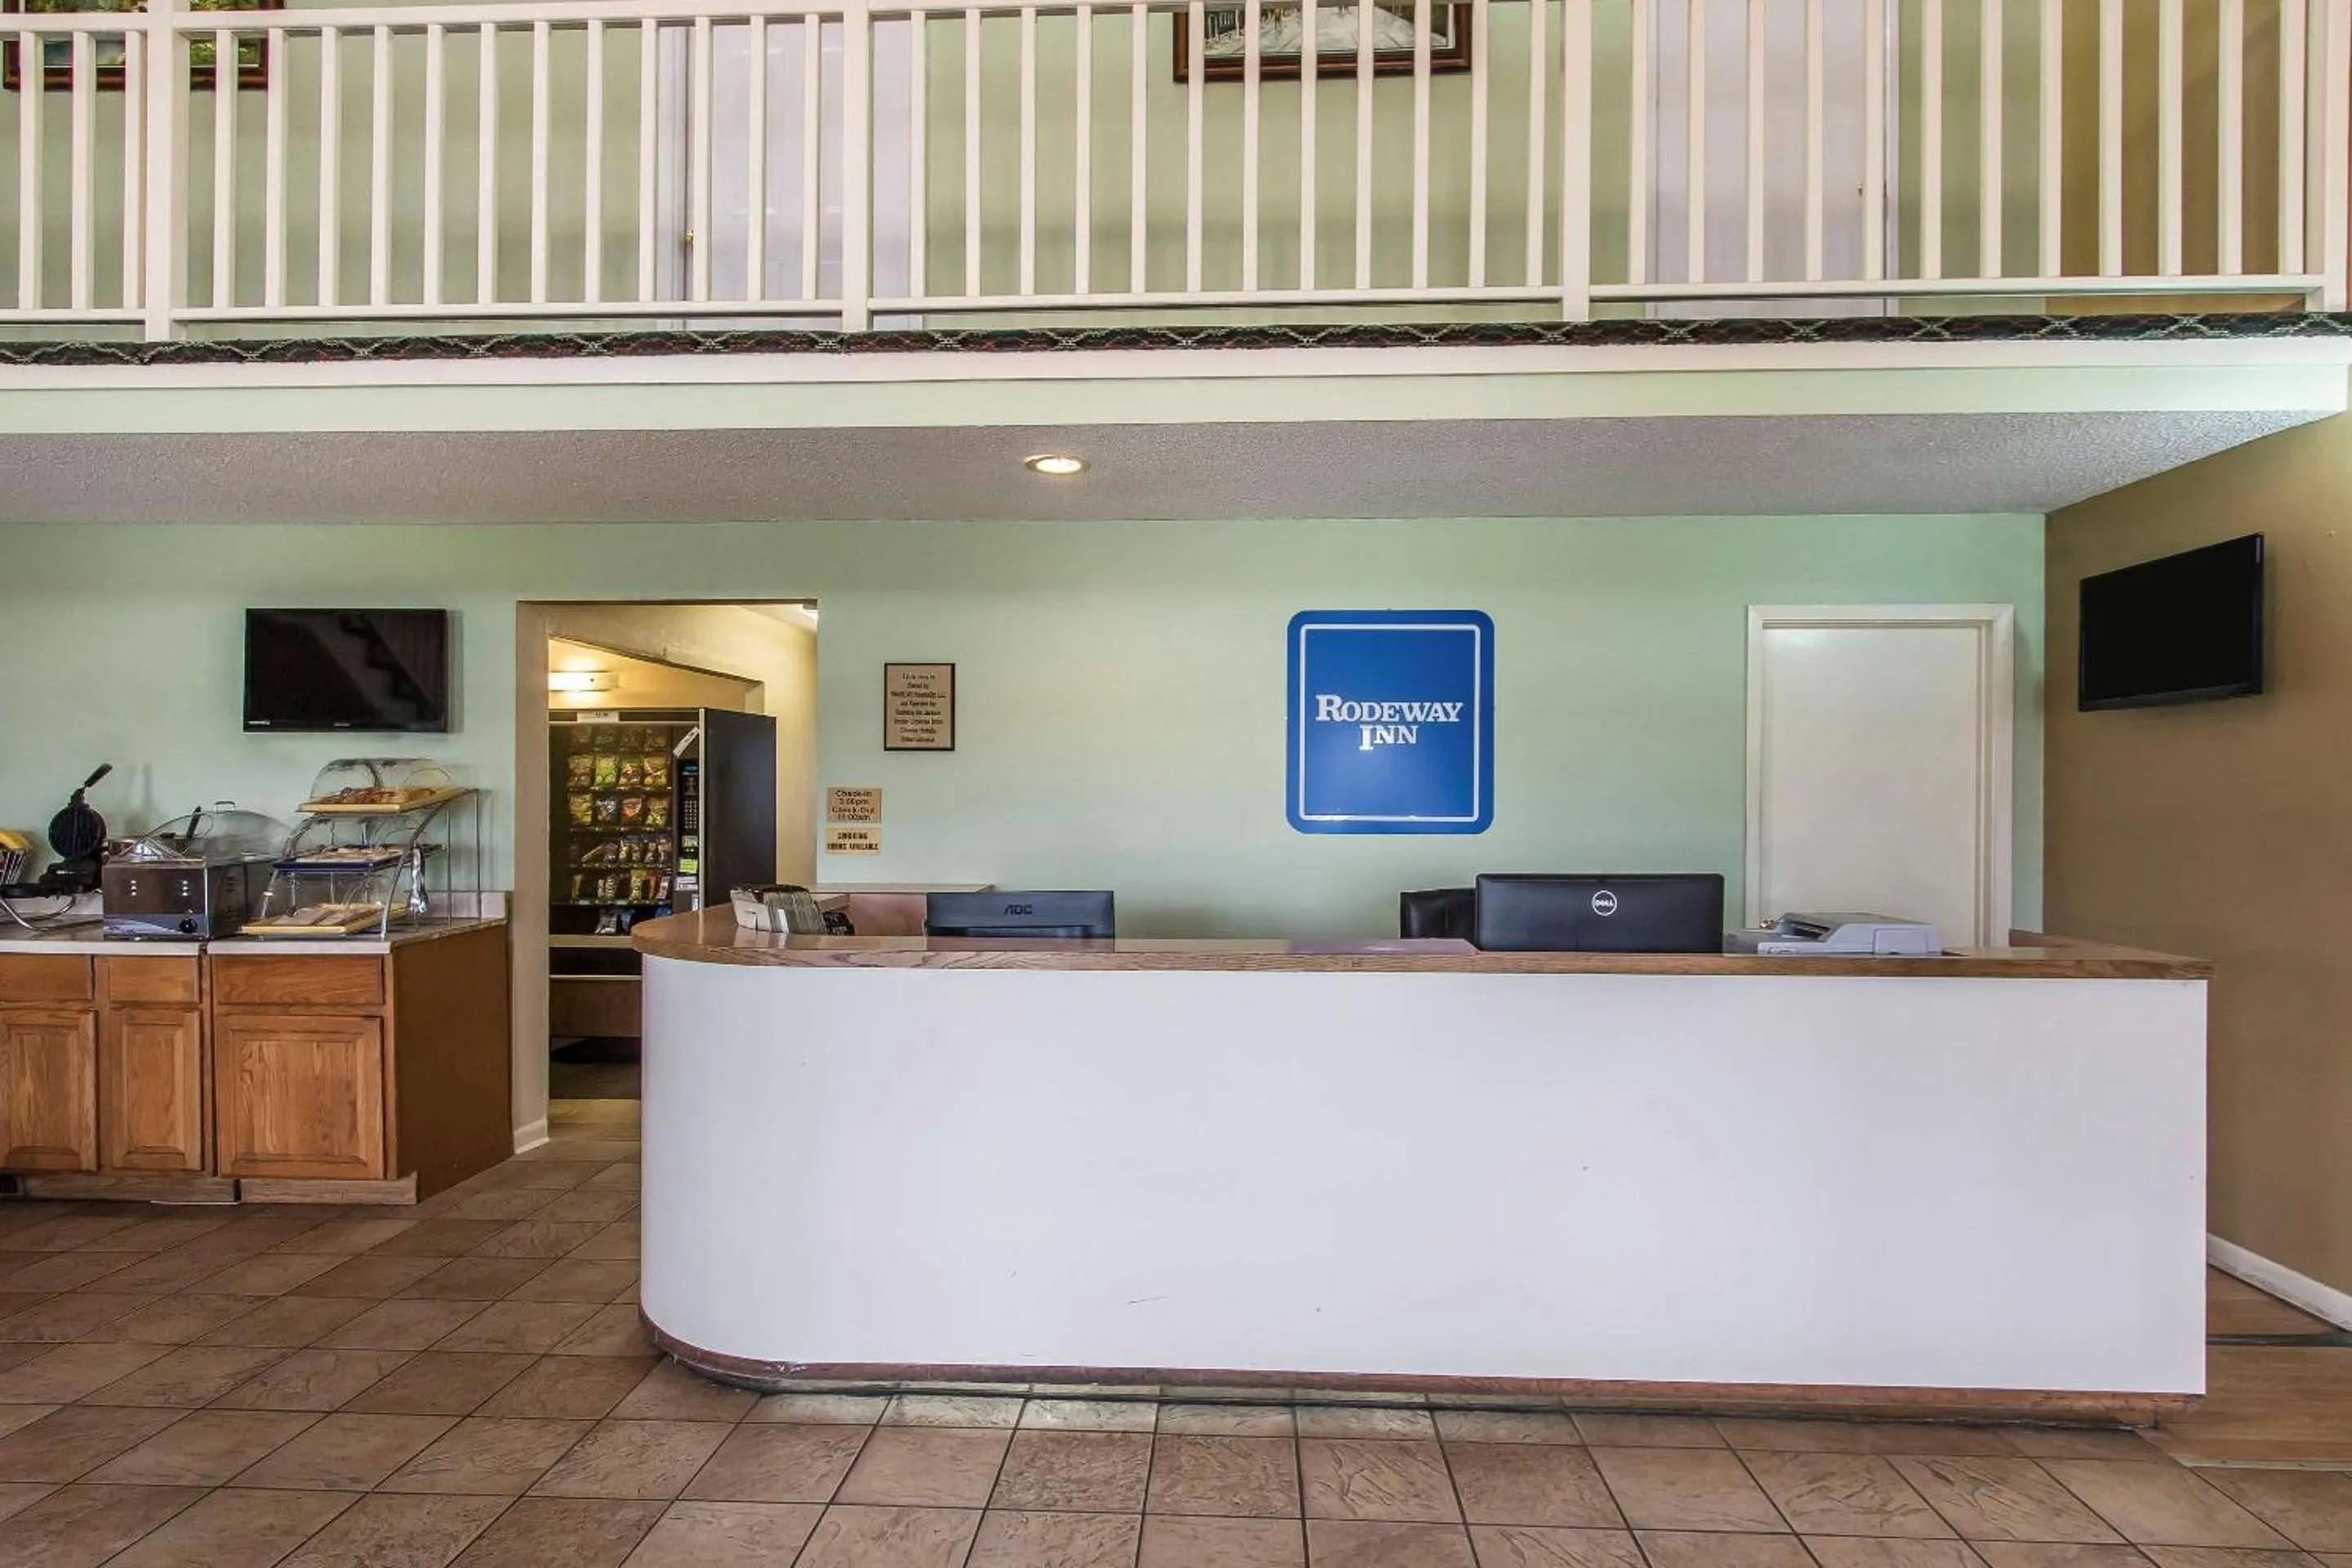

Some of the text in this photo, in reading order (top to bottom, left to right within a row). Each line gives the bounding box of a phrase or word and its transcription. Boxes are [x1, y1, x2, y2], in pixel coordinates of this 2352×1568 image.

[1316, 694, 1464, 722] RODEWAY
[1359, 724, 1419, 751] INN
[1003, 904, 1033, 915] AOC
[1594, 899, 1615, 907] DELL
